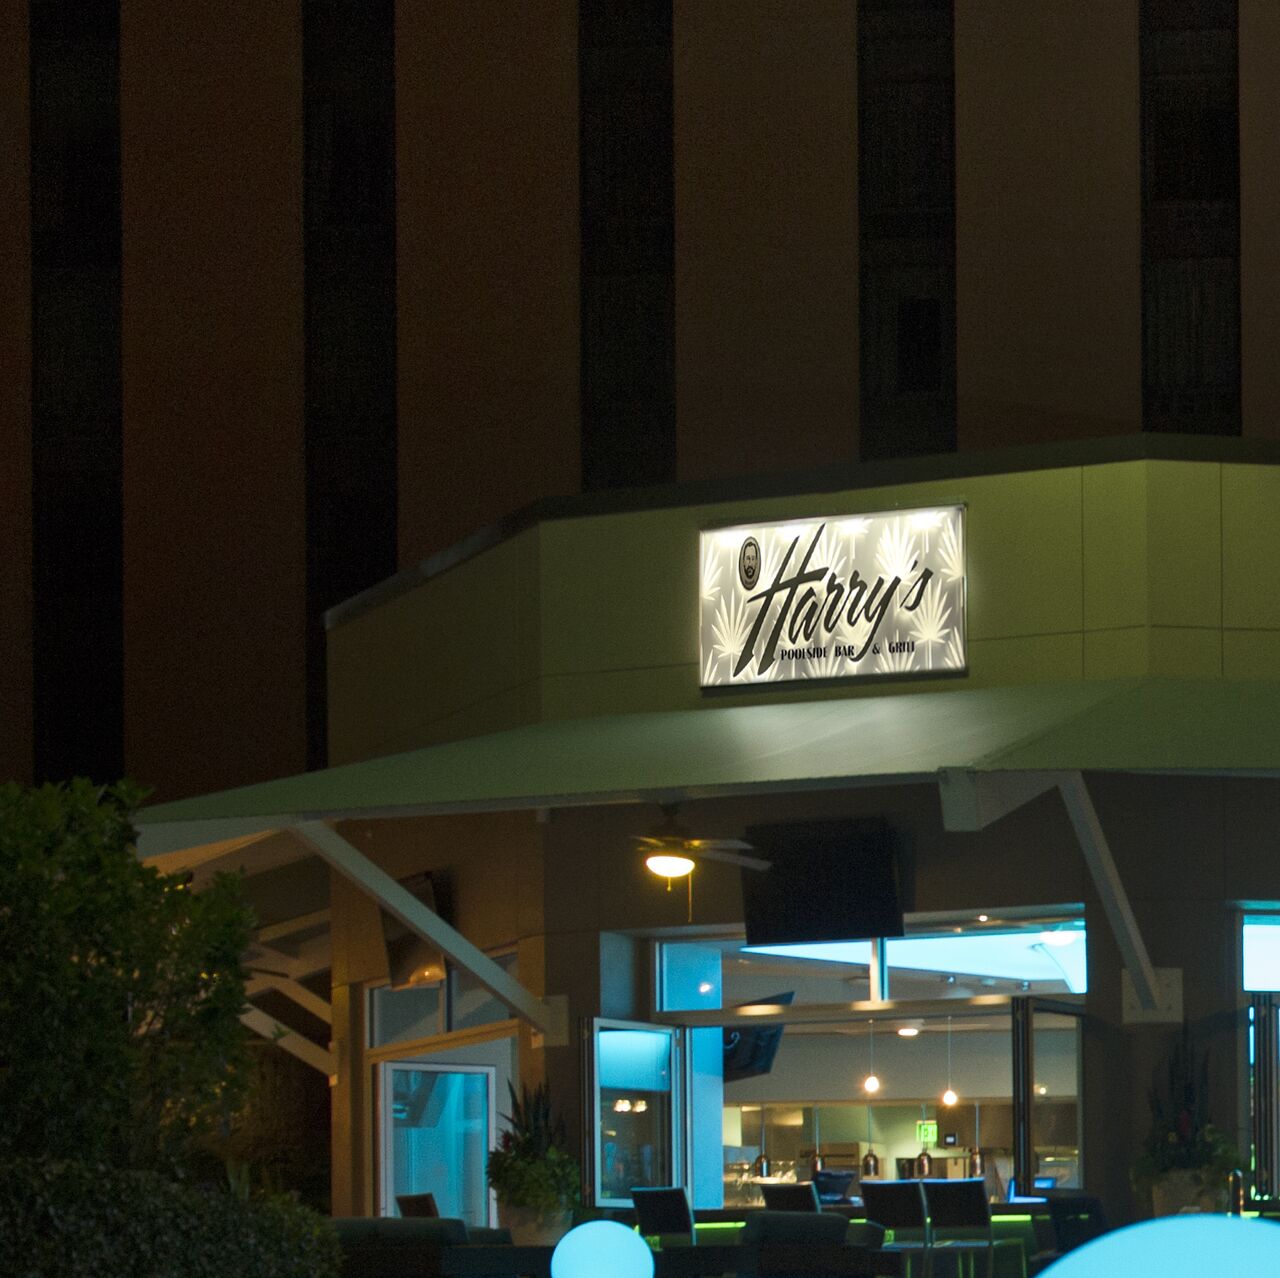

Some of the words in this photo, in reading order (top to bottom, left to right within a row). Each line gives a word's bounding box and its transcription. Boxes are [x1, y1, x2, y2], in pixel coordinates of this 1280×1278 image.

[733, 522, 934, 677] Harry's
[781, 646, 827, 661] POOLSIDE
[834, 644, 855, 658] BAR
[871, 642, 881, 655] &
[888, 640, 915, 654] GRILL
